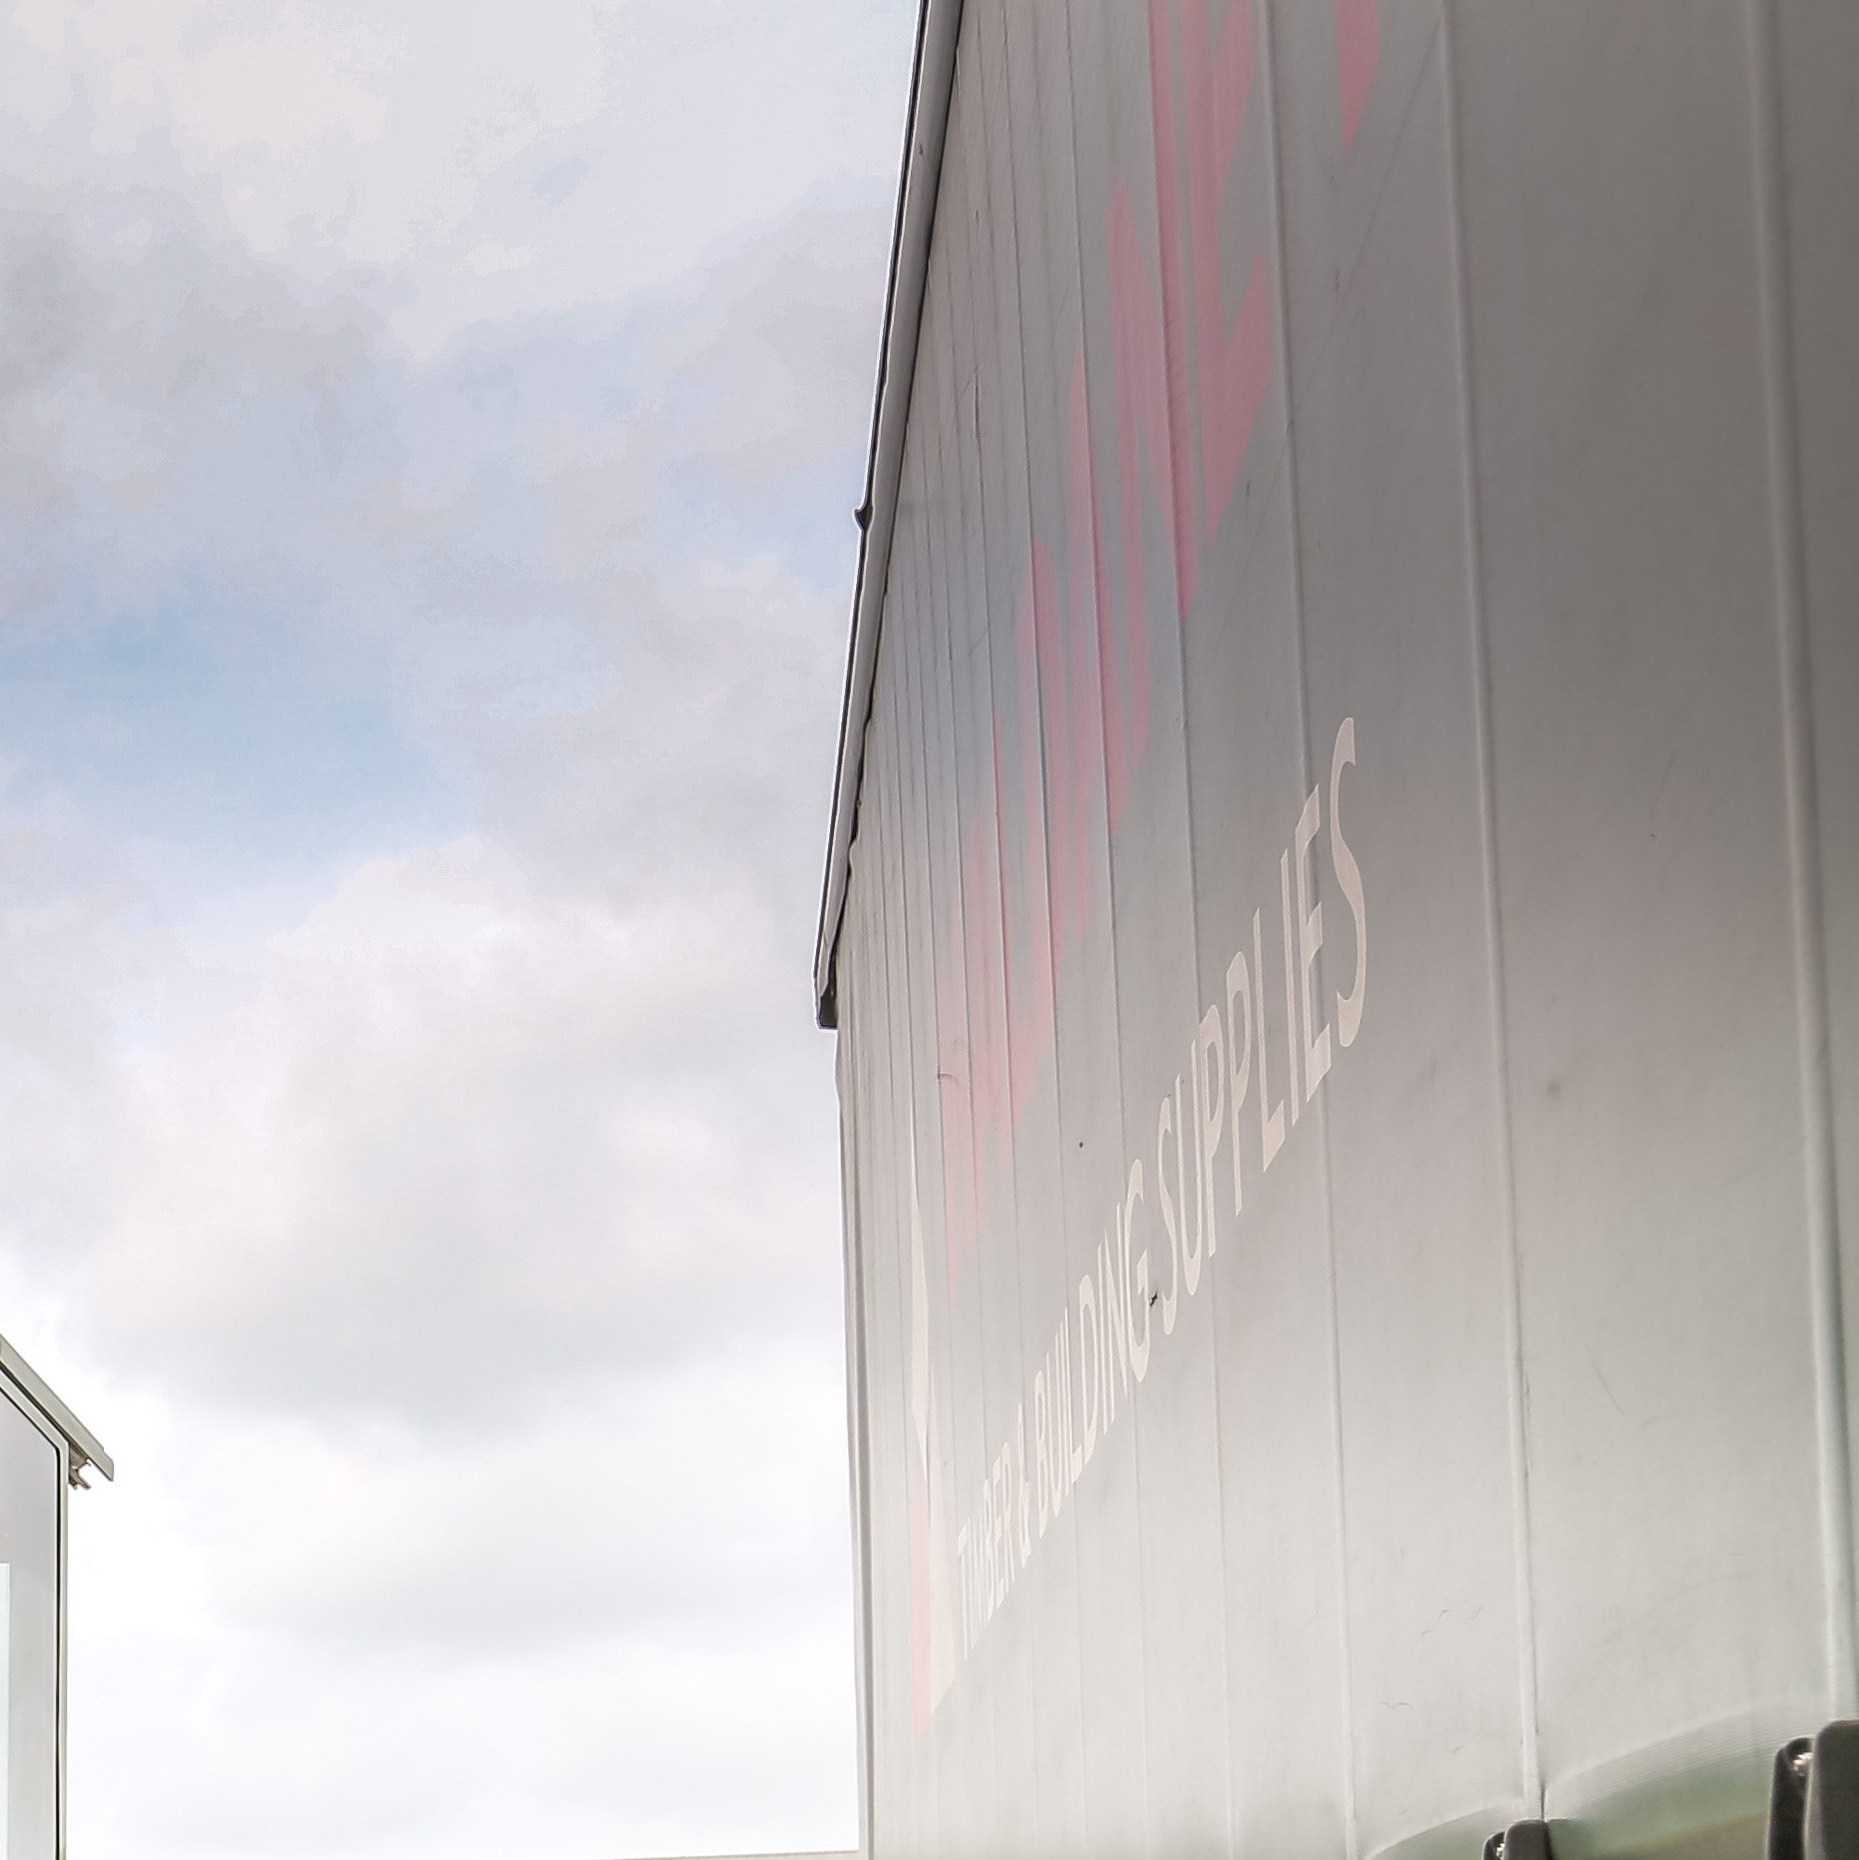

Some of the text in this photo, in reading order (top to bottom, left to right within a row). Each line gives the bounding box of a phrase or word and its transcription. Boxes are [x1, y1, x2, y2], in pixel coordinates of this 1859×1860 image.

[957, 717, 1367, 1662] TIMBER & BUILDING SUPPLIES
